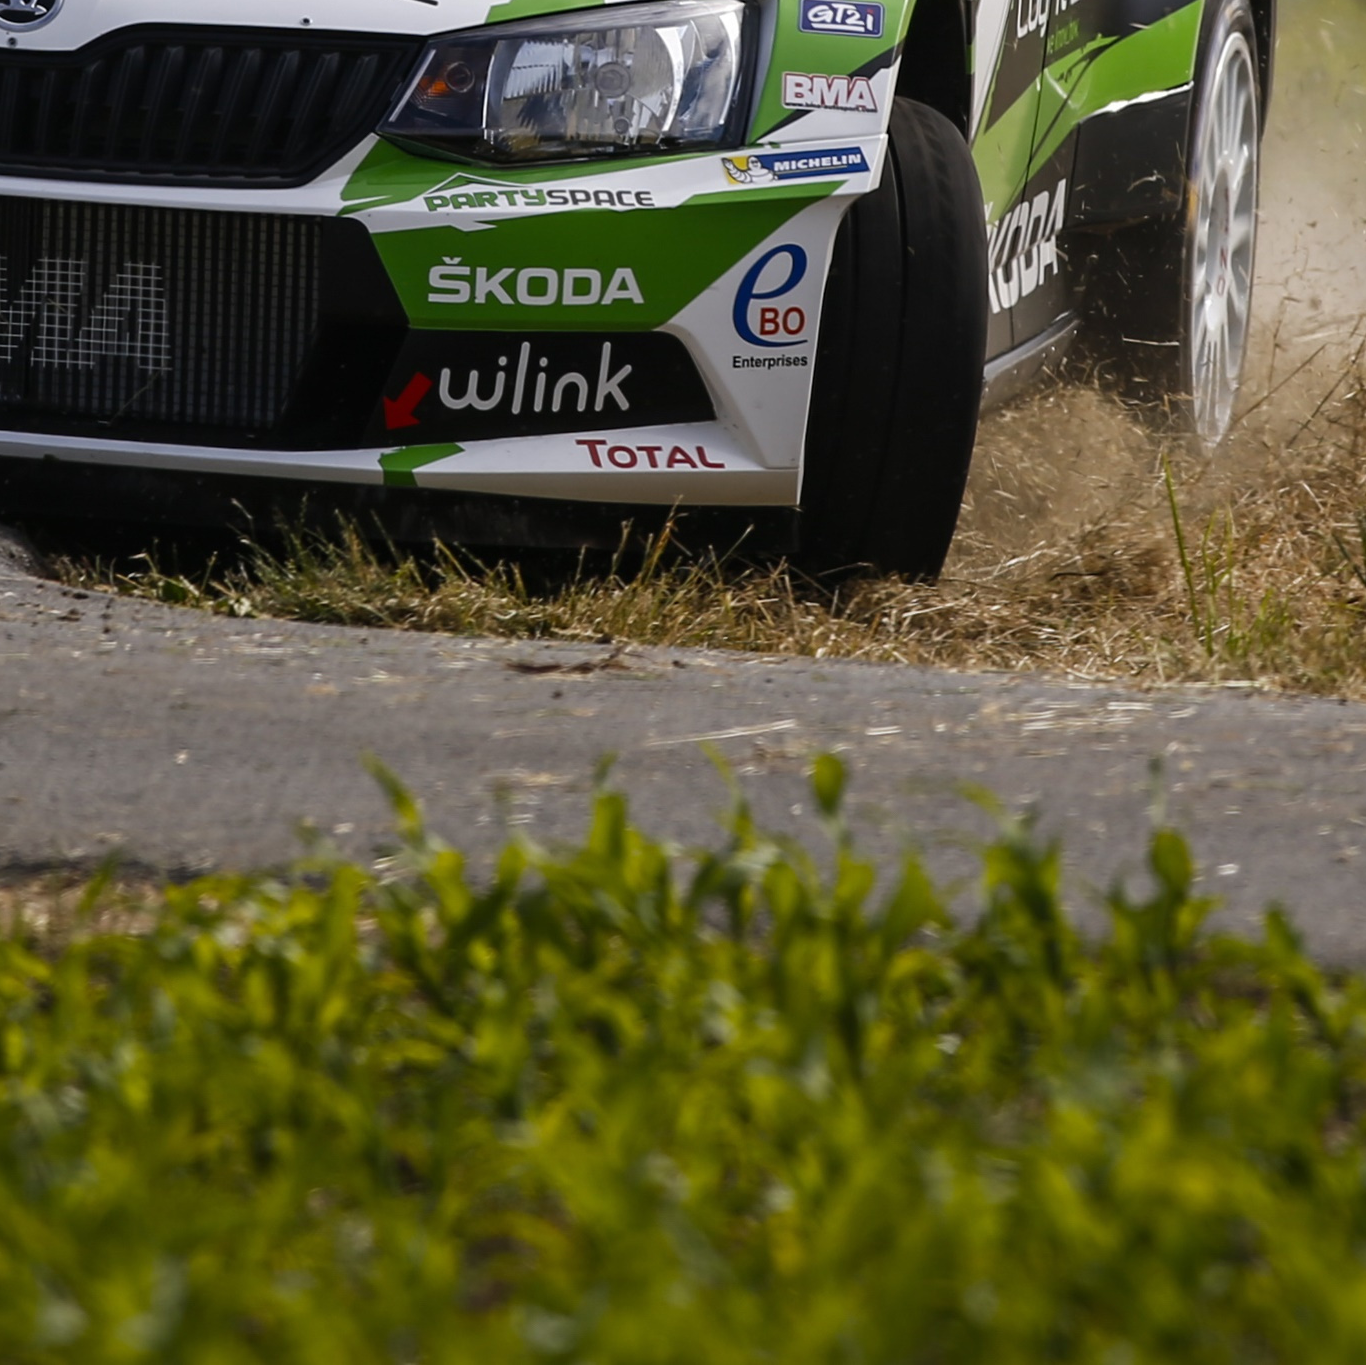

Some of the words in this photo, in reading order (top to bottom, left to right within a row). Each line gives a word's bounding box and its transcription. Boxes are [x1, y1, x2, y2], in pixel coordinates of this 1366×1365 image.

[784, 73, 877, 108] BMA
[773, 153, 863, 172] MICHELIN
[428, 257, 645, 305] ŠKODA
[759, 306, 805, 336] BO
[732, 354, 808, 371] Enterprises
[575, 439, 725, 469] TOTAL
